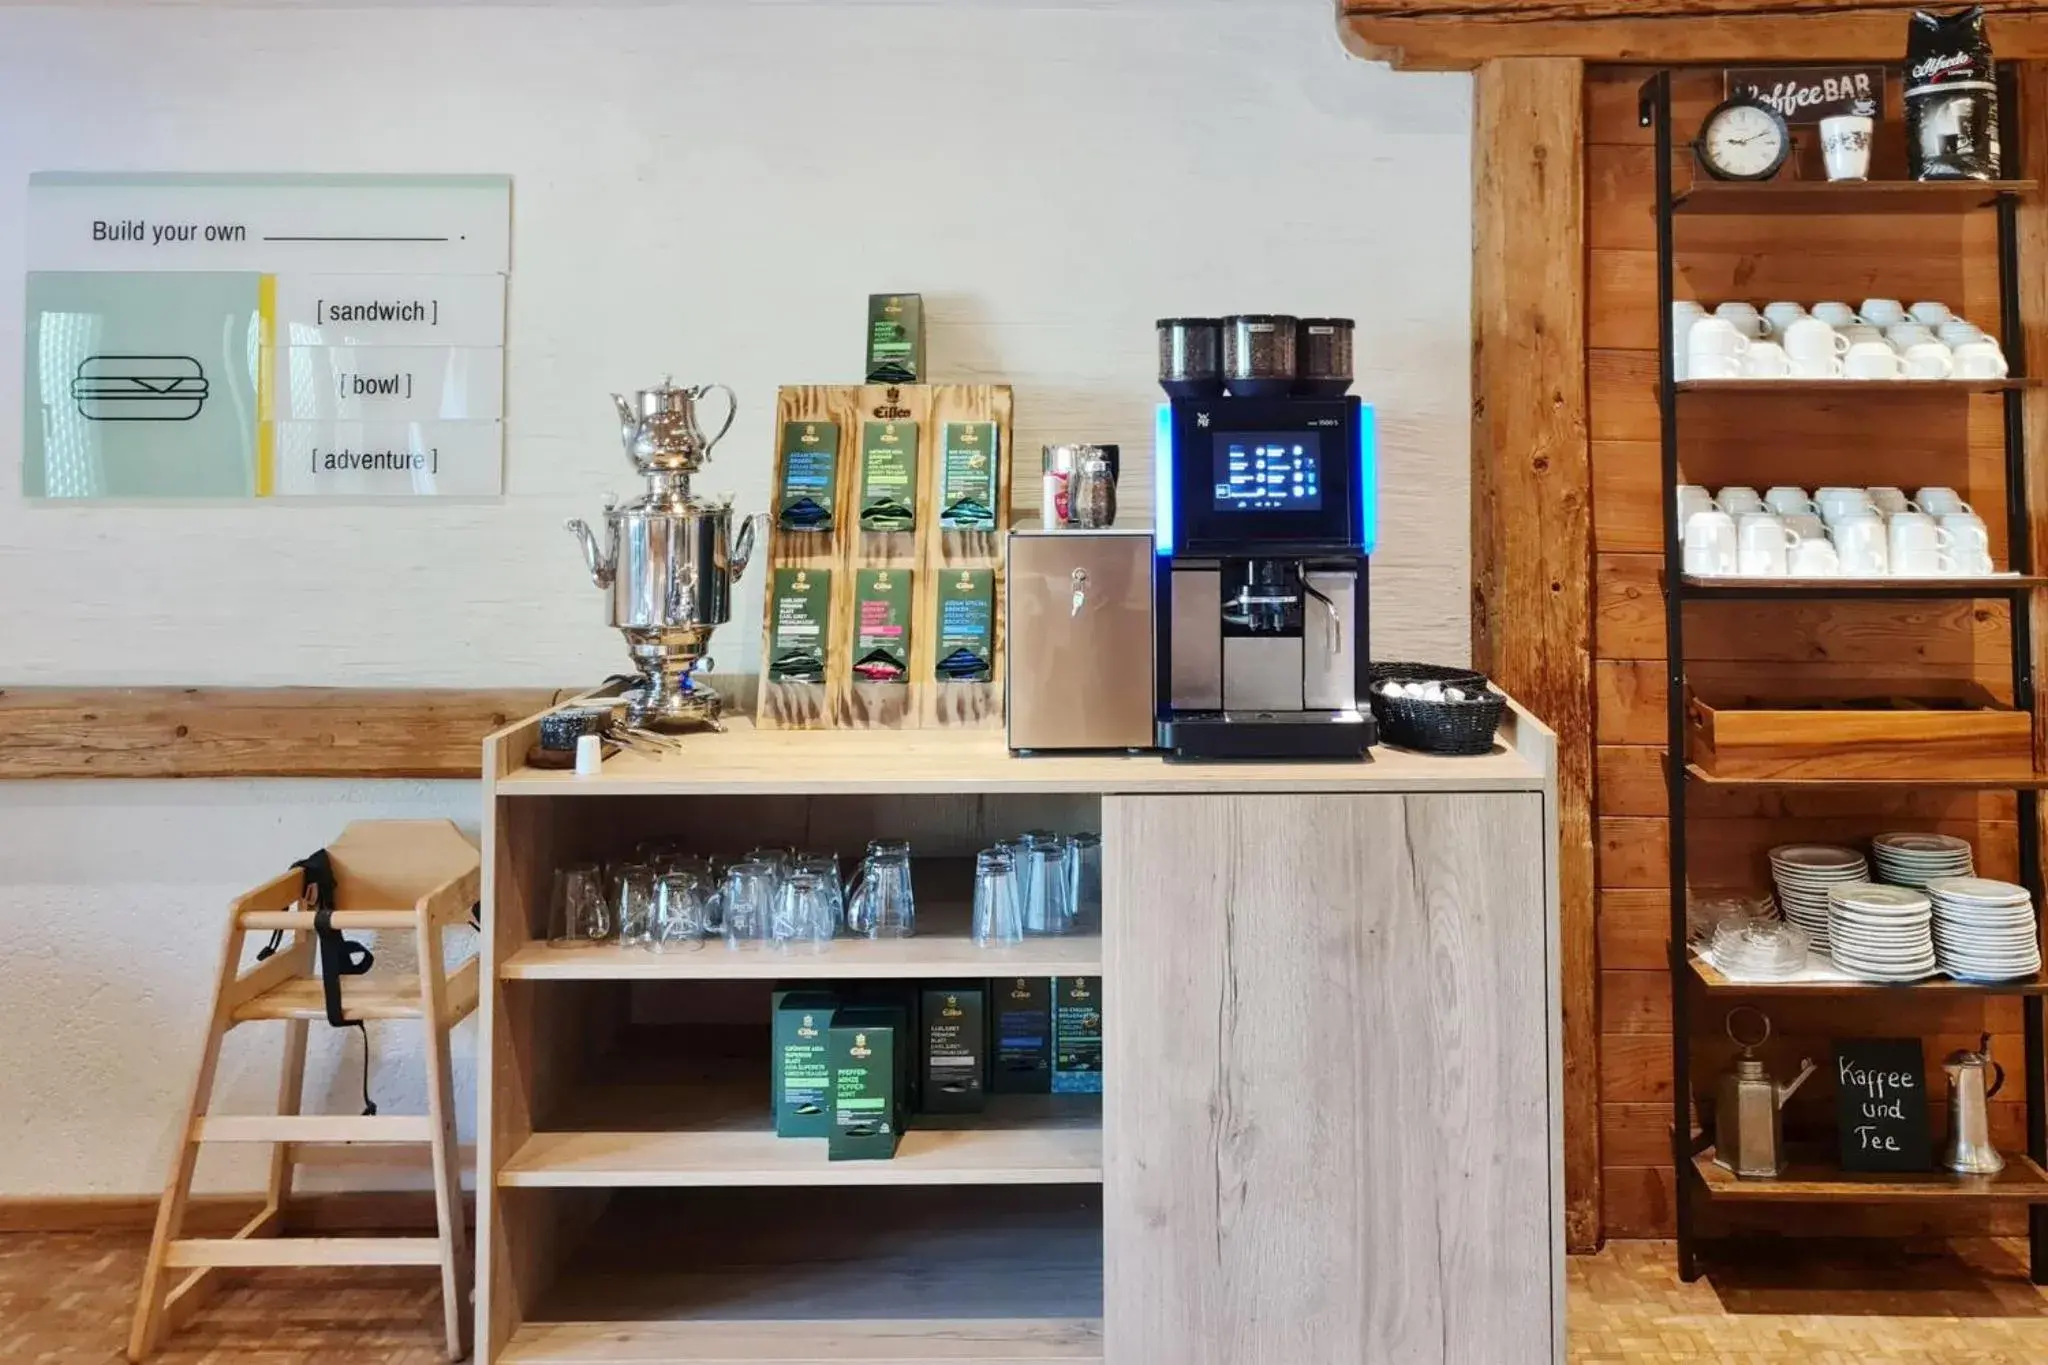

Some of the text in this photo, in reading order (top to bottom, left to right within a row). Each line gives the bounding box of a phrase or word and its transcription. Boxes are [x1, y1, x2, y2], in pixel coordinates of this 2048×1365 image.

[1912, 51, 1969, 78] Alfredo
[1823, 73, 1871, 102] BAR
[93, 220, 246, 246] Build your own
[329, 300, 425, 322] sandwich
[353, 373, 399, 396] bowl
[324, 449, 426, 471] adventure
[1839, 1055, 1915, 1099] Kaffee
[1862, 1098, 1906, 1120] und
[1853, 1125, 1901, 1151] Tee
